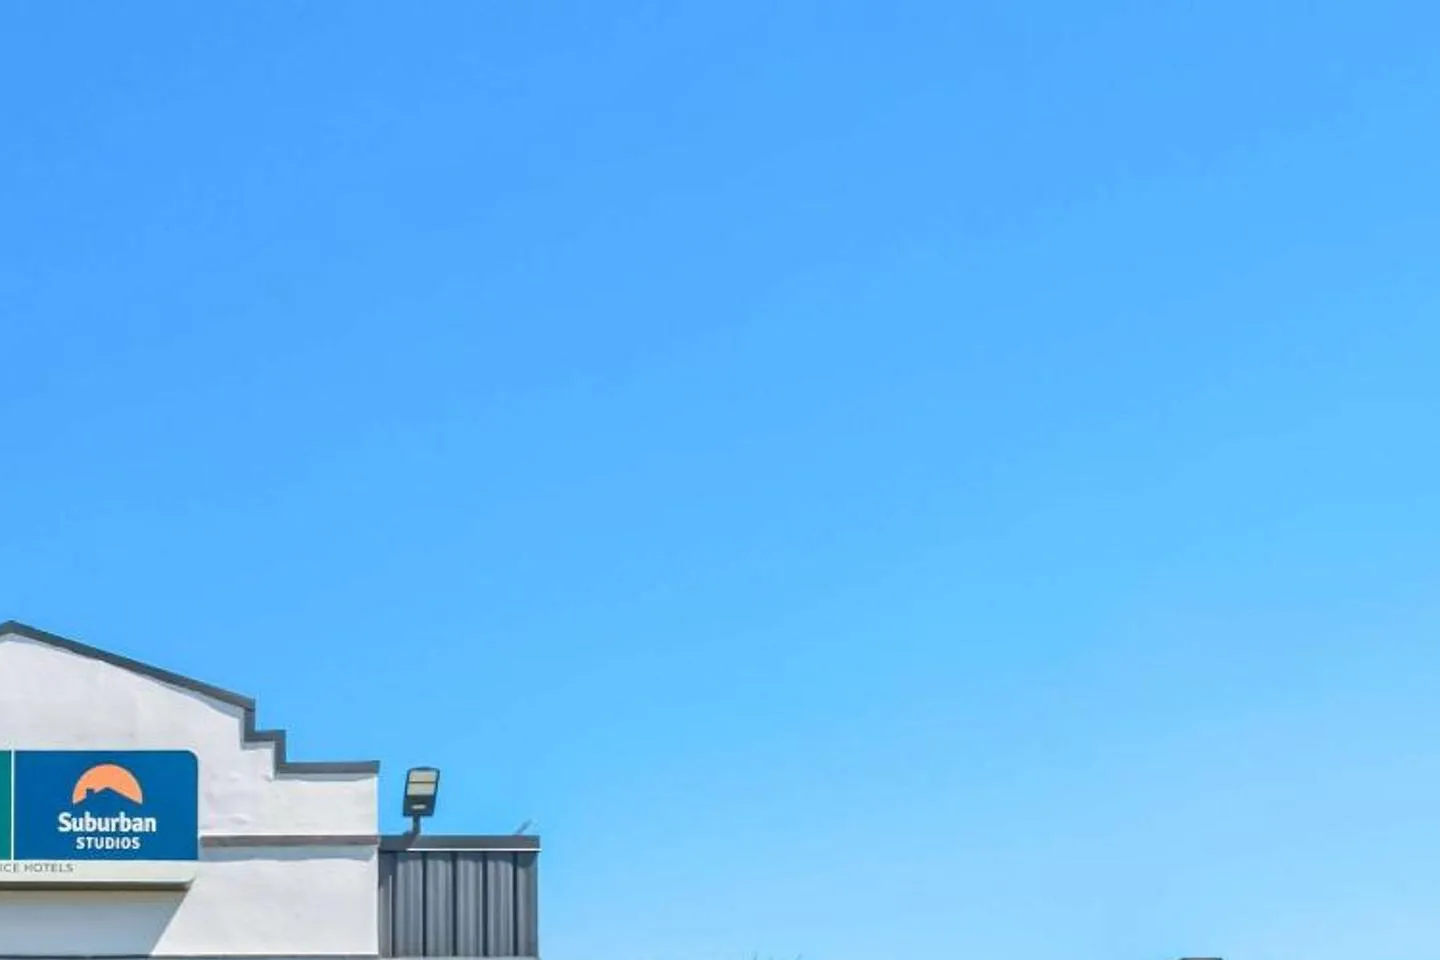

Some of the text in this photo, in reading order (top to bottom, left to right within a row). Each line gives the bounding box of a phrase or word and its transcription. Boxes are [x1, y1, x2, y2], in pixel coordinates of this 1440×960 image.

[58, 811, 157, 833] Suburban
[76, 836, 140, 849] STUDIOS
[24, 863, 74, 873] HOTELS
